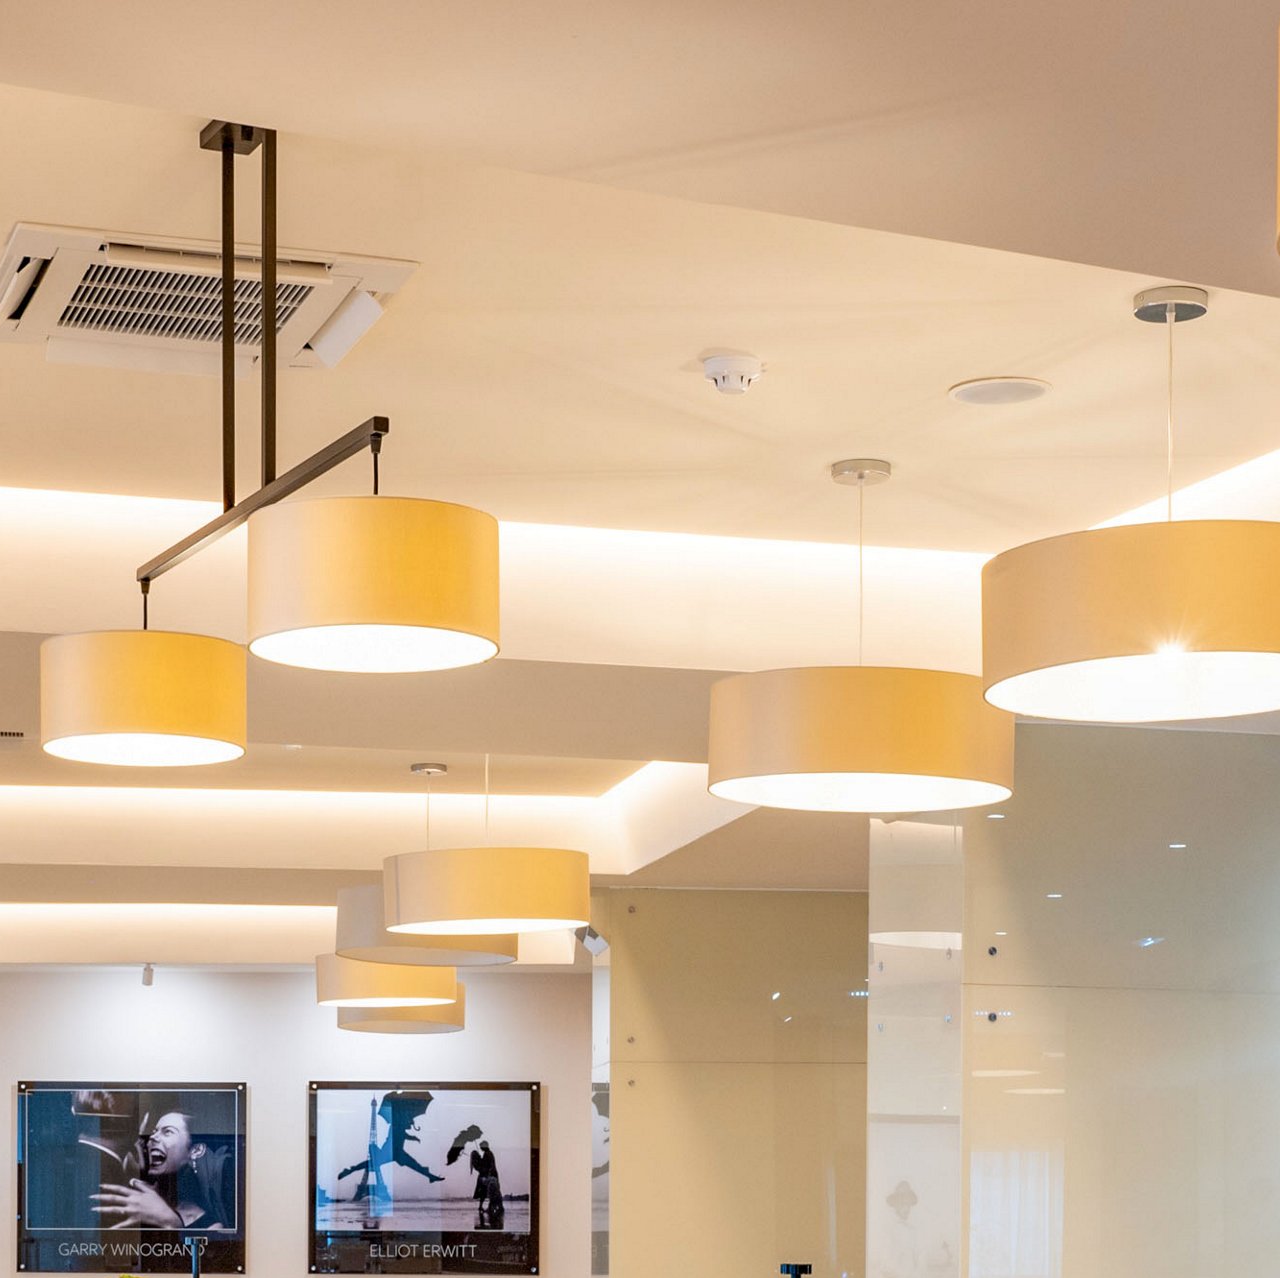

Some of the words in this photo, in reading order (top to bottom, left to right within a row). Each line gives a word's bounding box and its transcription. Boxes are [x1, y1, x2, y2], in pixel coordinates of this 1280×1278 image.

[58, 1242, 107, 1257] GARRY
[370, 1244, 419, 1258] ELLIOT
[423, 1244, 477, 1258] ERWITT
